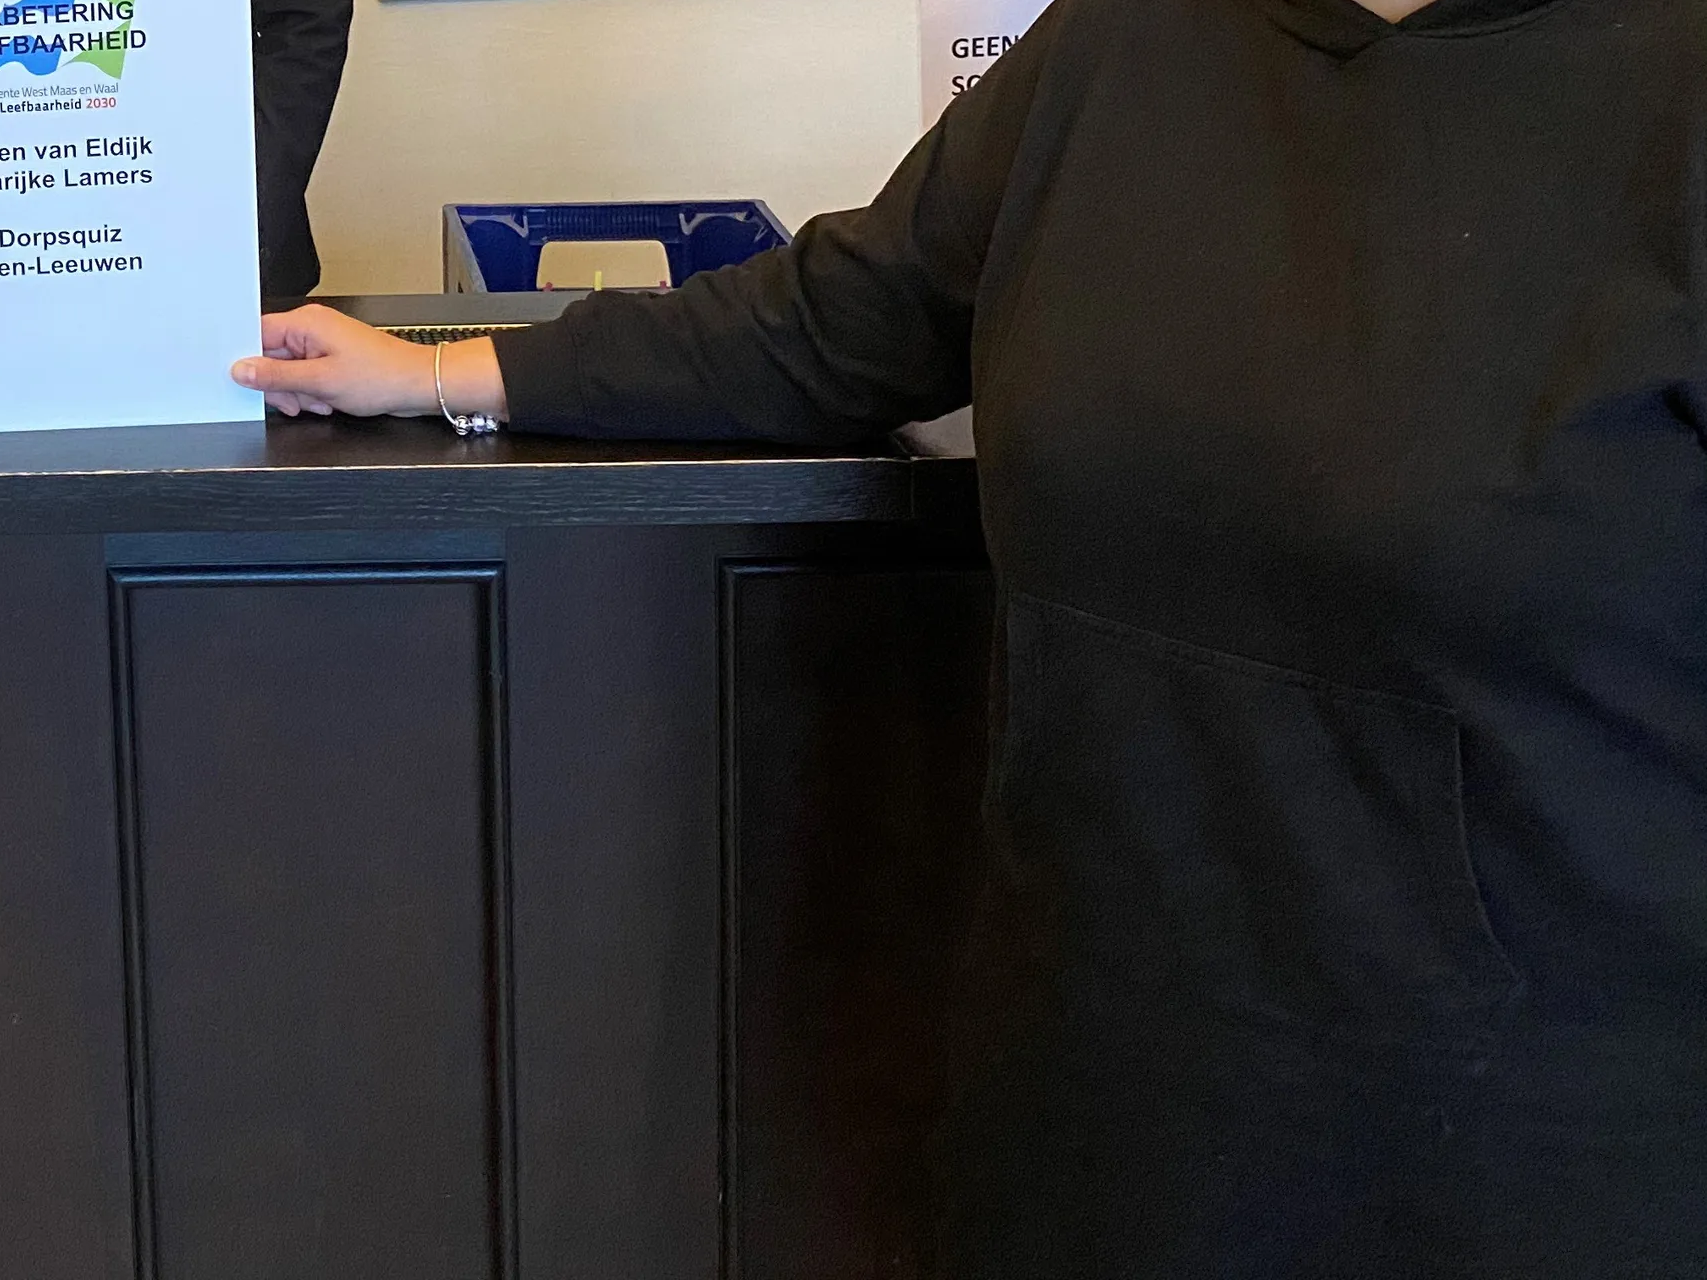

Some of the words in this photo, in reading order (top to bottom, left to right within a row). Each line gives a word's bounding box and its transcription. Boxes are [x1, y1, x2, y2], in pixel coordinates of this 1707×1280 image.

[21, 86, 48, 98] West
[50, 84, 78, 96] Maas
[79, 86, 92, 95] en
[94, 82, 119, 94] Waal
[0, 99, 82, 114] Leefbaarheid
[86, 97, 117, 109] 2030
[34, 144, 77, 160] van
[86, 136, 154, 161] Eldijk
[64, 168, 153, 188] Lamers
[0, 223, 123, 250] Dorpsquiz
